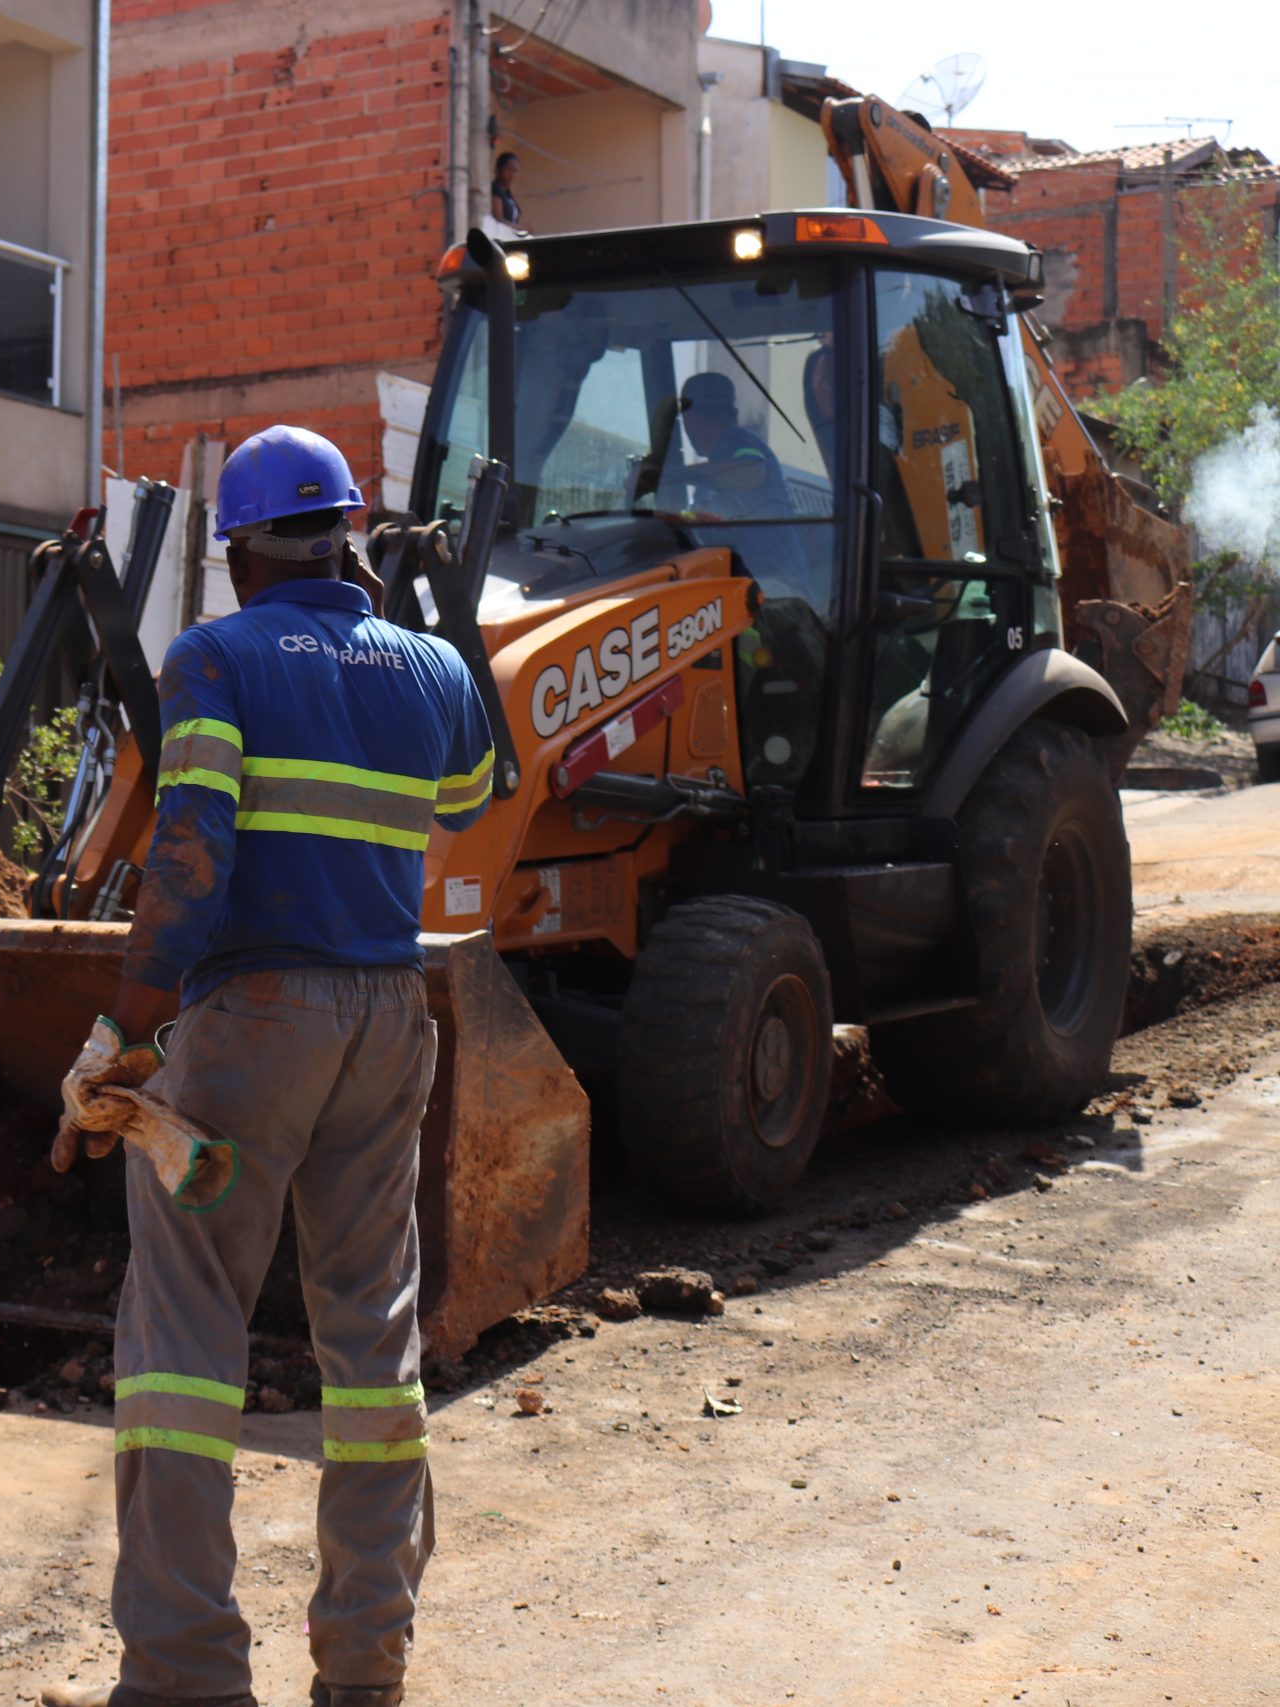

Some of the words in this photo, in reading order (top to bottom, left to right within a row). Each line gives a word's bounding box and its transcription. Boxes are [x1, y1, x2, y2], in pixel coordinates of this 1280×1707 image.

[531, 605, 660, 738] CASE
[667, 597, 722, 658] 580N
[1007, 626, 1023, 650] 05
